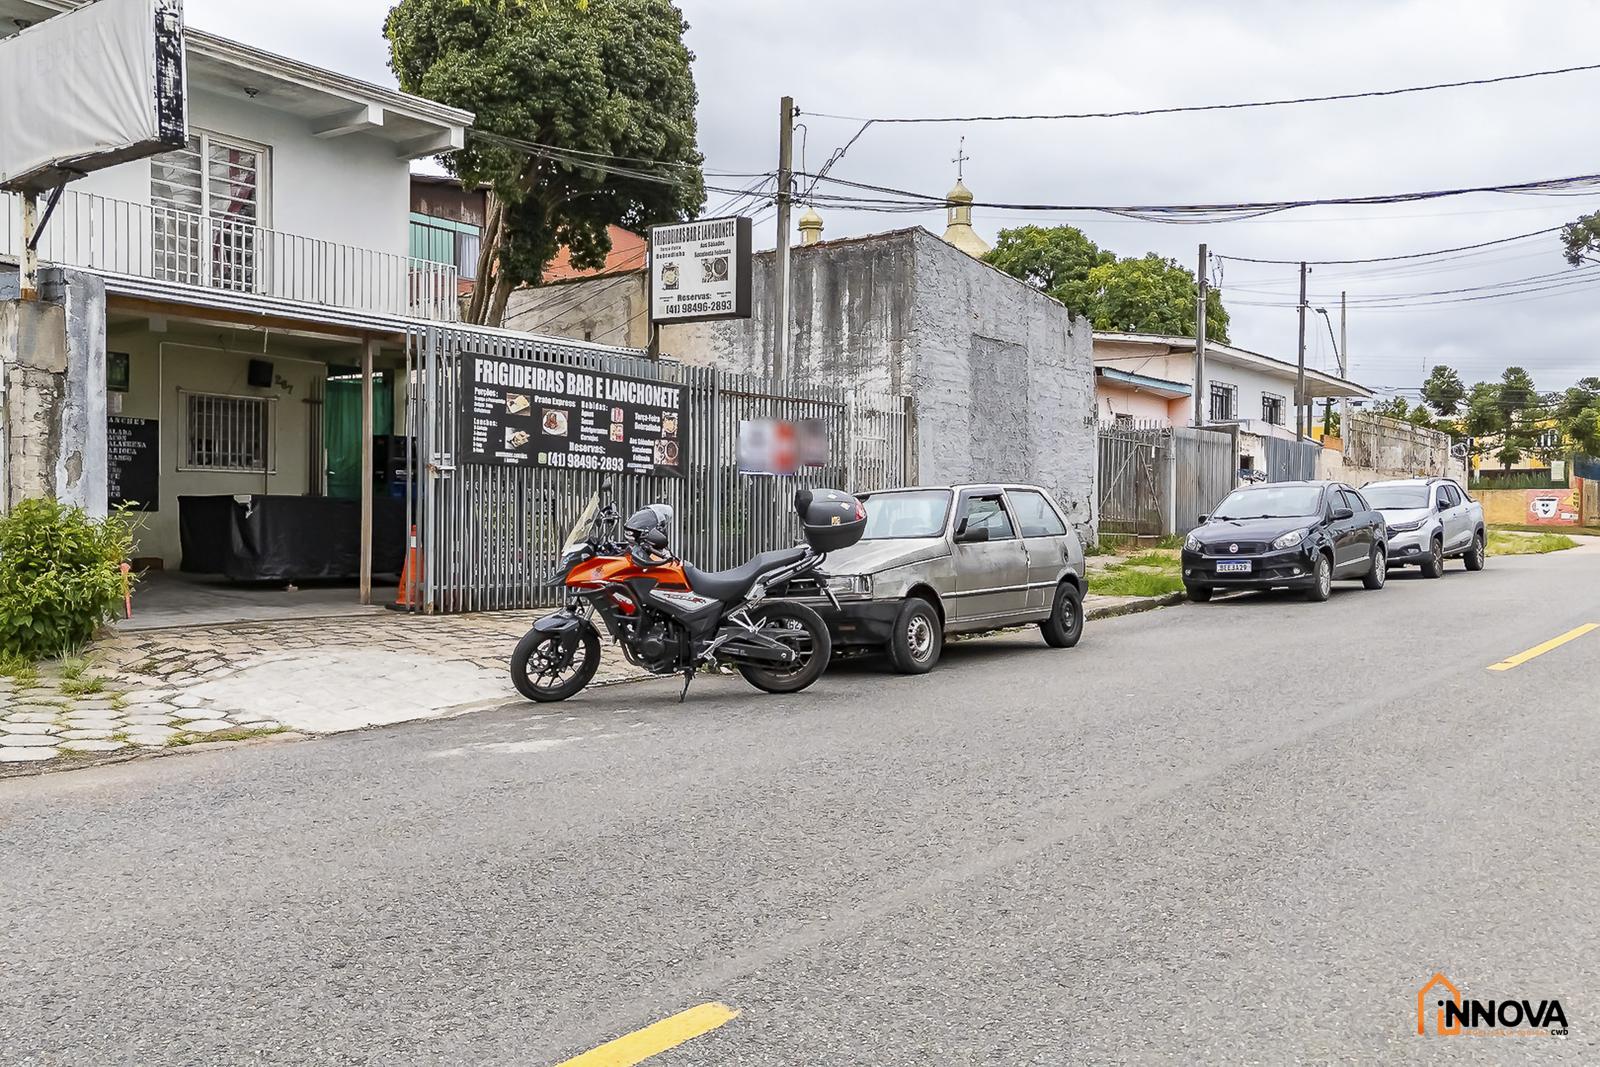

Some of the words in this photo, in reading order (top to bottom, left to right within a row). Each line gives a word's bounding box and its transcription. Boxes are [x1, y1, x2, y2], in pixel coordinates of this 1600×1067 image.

[686, 226, 697, 242] BAR
[701, 221, 735, 241] LANCHONETE
[677, 293, 712, 302] Reservas:
[666, 304, 680, 314] (41)
[682, 300, 732, 313] 98496-2893
[474, 358, 565, 394] FRIGIDEIRAS
[566, 372, 594, 398] BAR
[596, 377, 603, 399] E
[605, 378, 680, 410] LANCHONETE
[108, 417, 145, 425] ANCHES
[569, 441, 606, 455] Reservas:
[567, 453, 624, 472] 98496-2893
